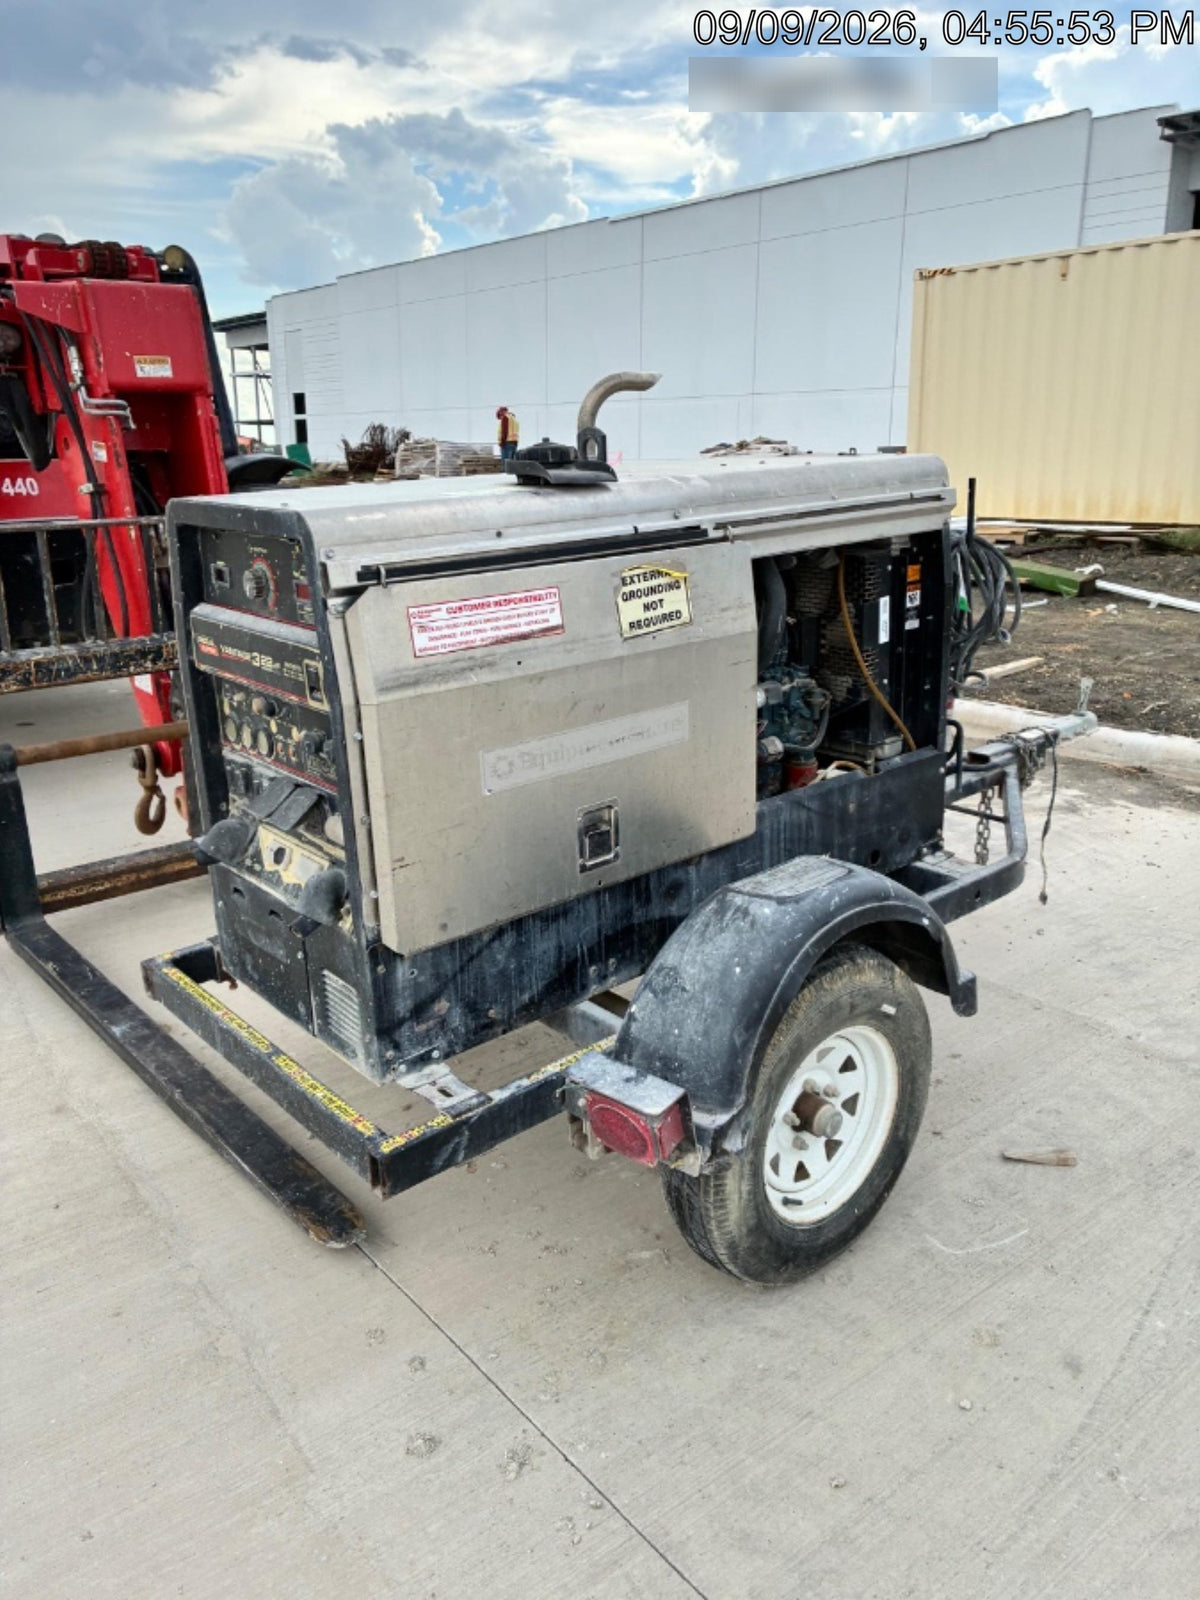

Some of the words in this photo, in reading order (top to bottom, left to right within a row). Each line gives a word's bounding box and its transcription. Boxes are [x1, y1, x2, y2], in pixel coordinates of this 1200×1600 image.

[2, 477, 39, 496] 440
[621, 569, 672, 587] EXTERNA
[621, 579, 682, 602] GROUNDING
[643, 598, 664, 613] NOT
[629, 609, 682, 631] REQUIRED
